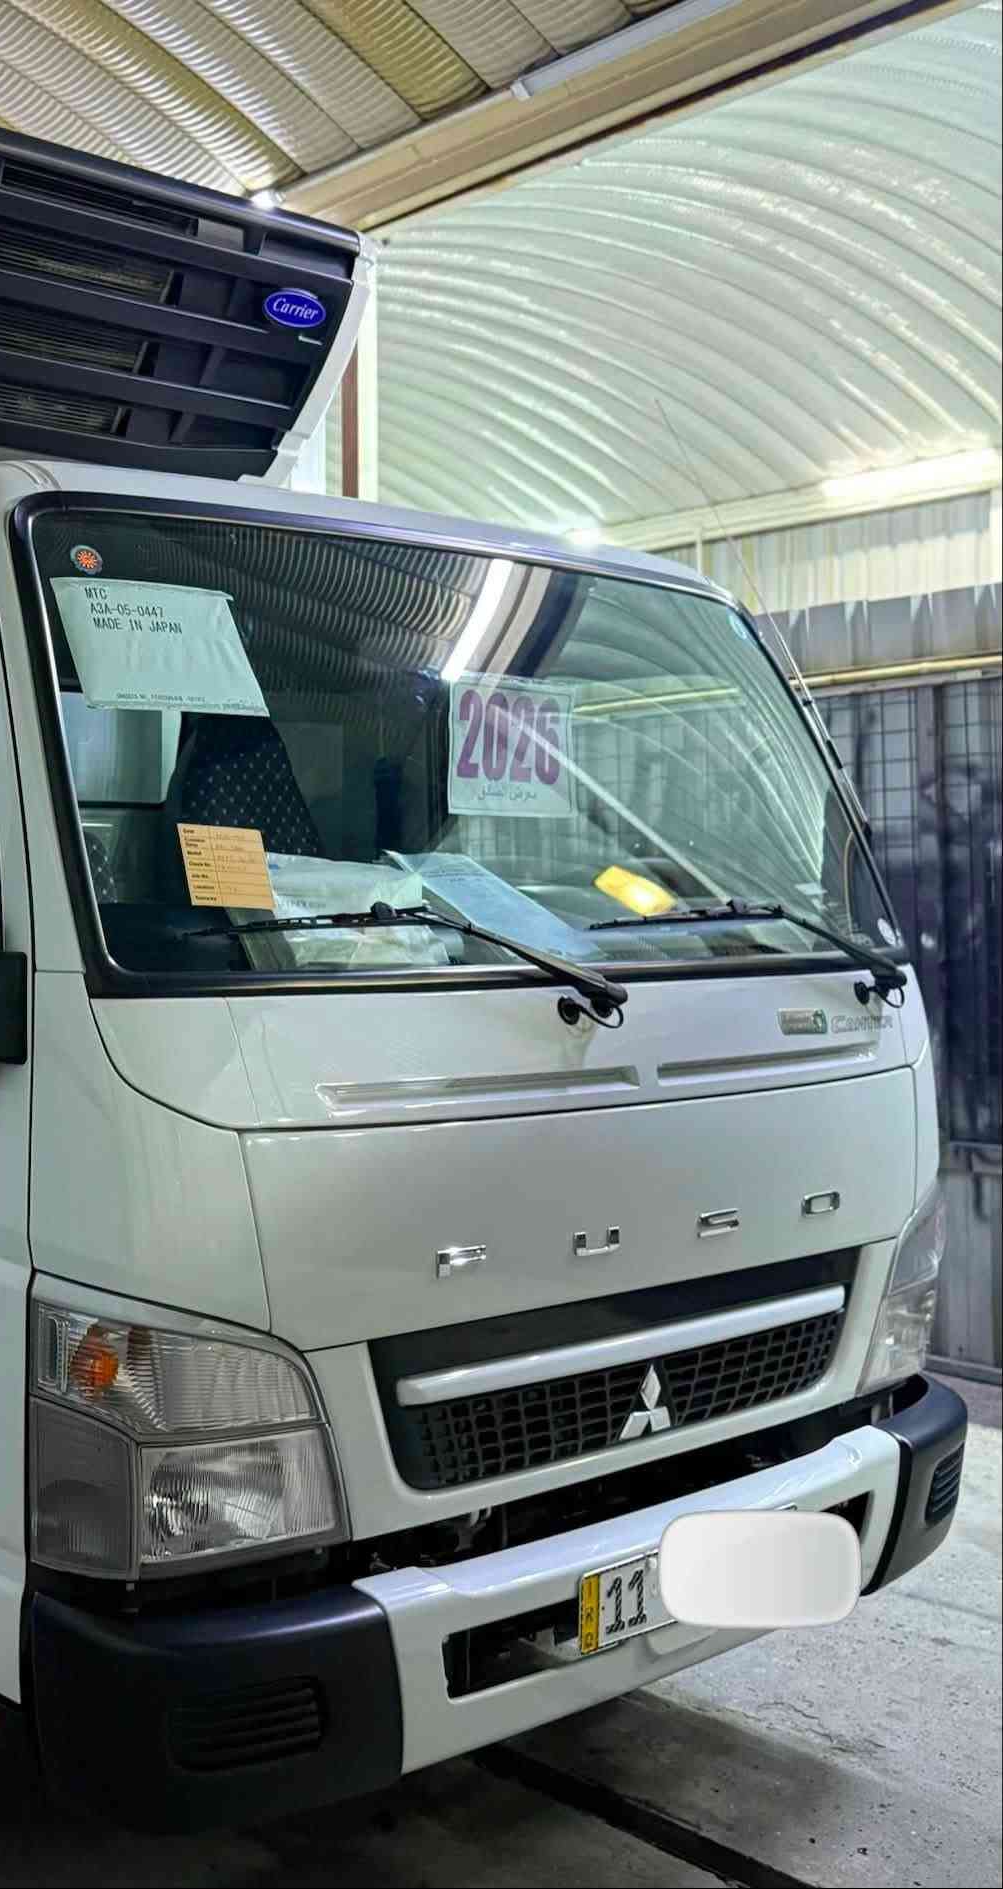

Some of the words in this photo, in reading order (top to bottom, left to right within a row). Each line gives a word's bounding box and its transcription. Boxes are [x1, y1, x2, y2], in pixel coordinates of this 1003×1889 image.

[272, 297, 319, 320] Carrier
[84, 586, 108, 601] MTC
[90, 602, 164, 618] A3A-05-0447
[93, 617, 124, 631] MADE
[128, 618, 143, 632] IN
[149, 620, 183, 635] JAPAN
[456, 689, 561, 786] 2026
[436, 1191, 841, 1280] FUSO
[606, 1568, 648, 1635] 11
